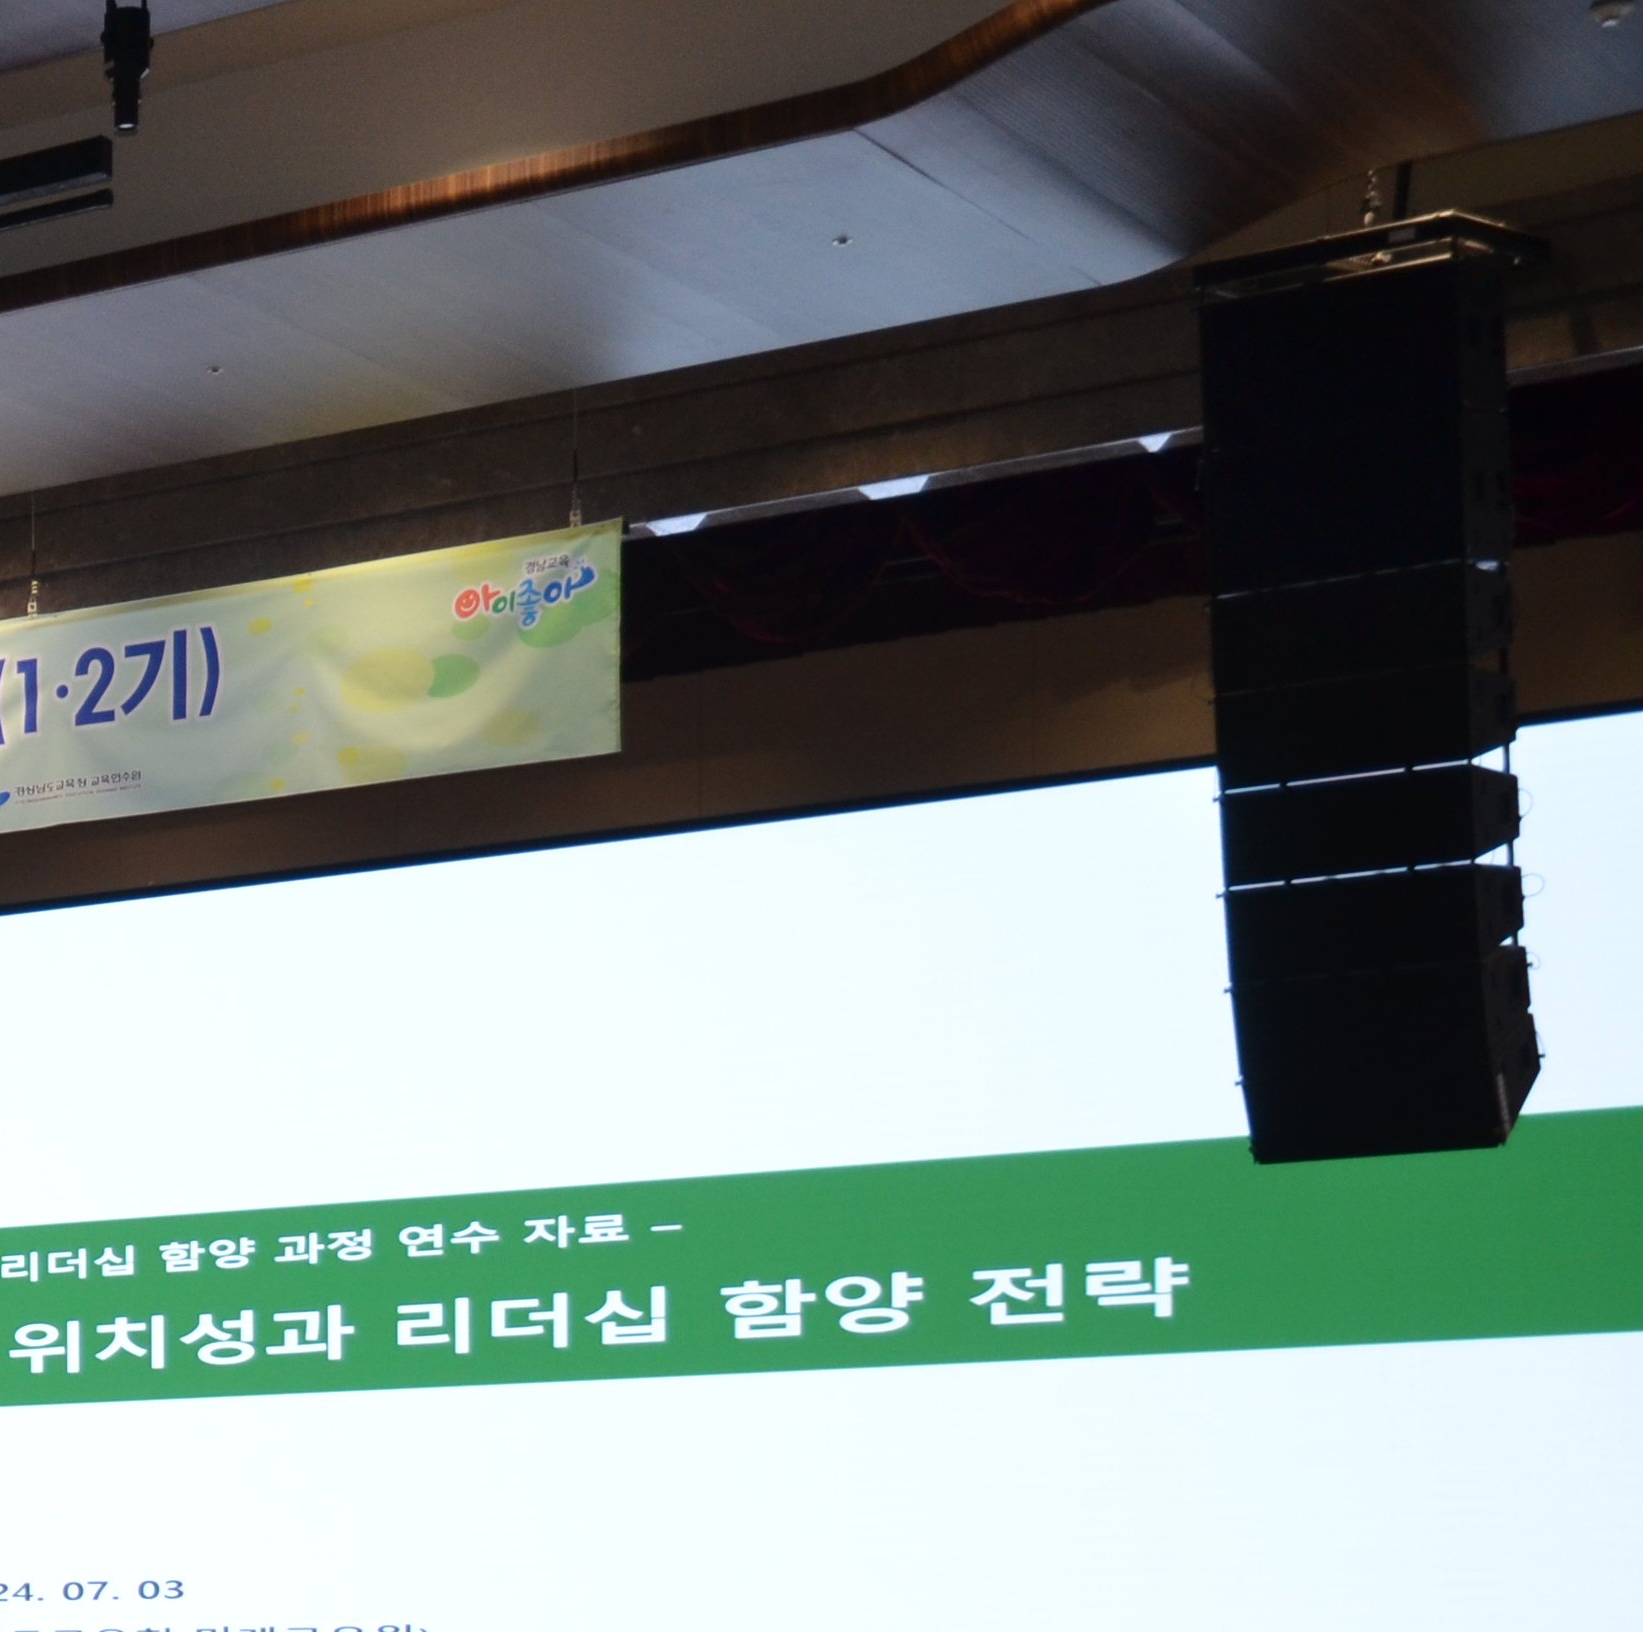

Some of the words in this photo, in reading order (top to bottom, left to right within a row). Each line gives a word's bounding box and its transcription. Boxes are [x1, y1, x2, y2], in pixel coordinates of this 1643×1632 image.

[525, 554, 571, 575] 경남교육
[455, 566, 595, 628] 아이좋아
[0, 1244, 135, 1282] 리더십
[159, 1236, 256, 1273] 함양
[274, 1227, 373, 1264] 과정
[398, 1221, 501, 1257] 연수
[523, 1214, 630, 1249] 자료
[8, 1304, 355, 1374] 위치성과
[397, 1285, 666, 1354] 리더십
[720, 1271, 924, 1339] 함양
[969, 1256, 1190, 1325] 전략
[62, 1581, 120, 1601] 07.
[137, 1579, 185, 1600] 03
